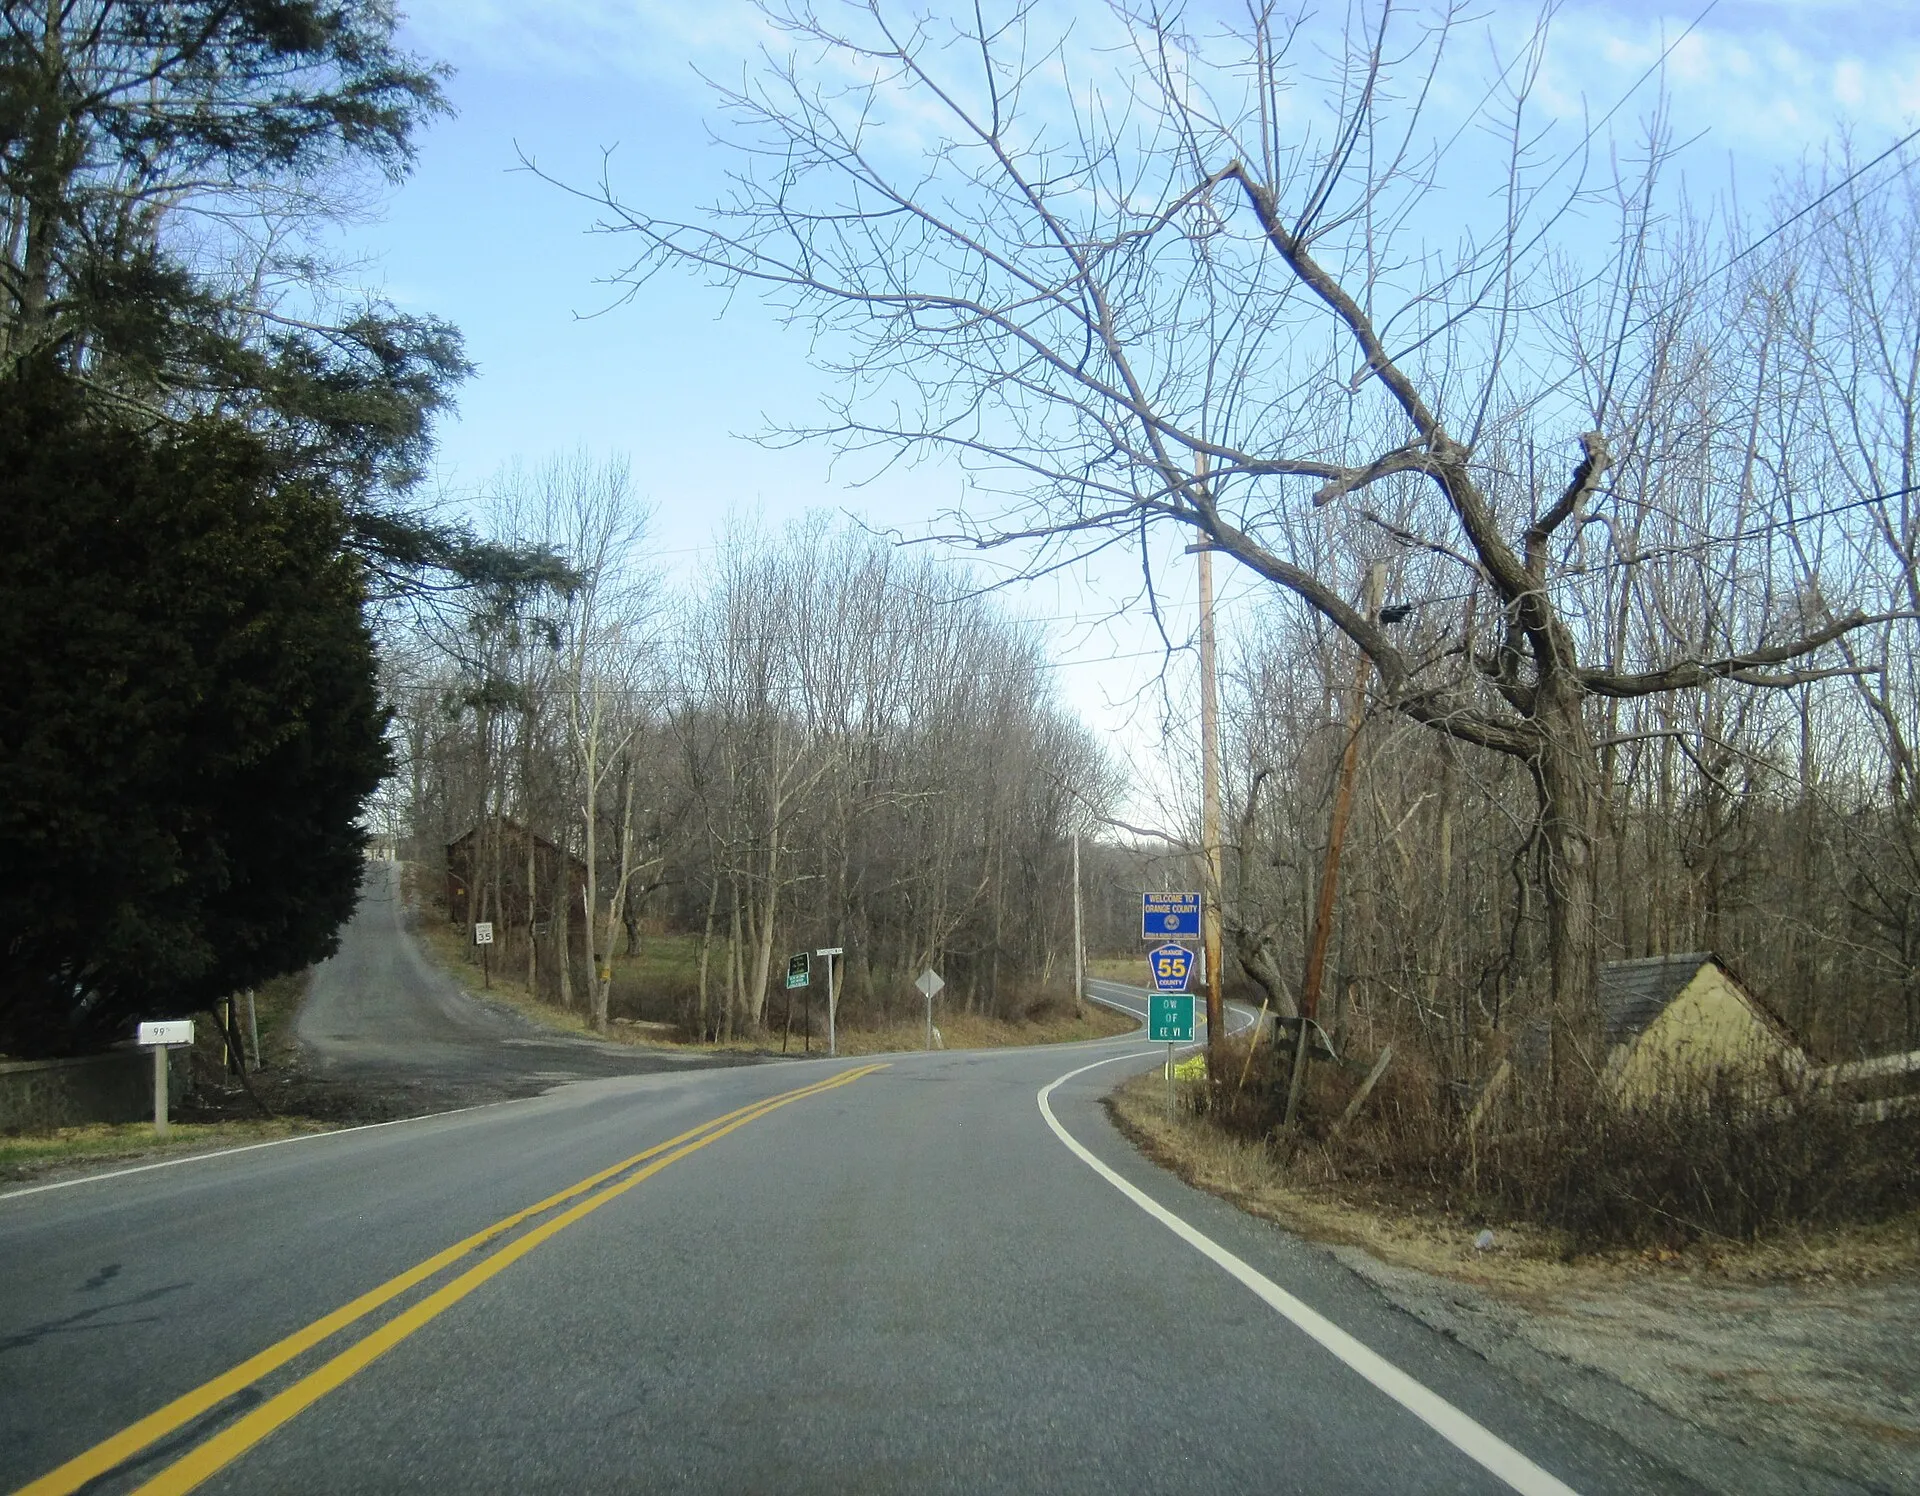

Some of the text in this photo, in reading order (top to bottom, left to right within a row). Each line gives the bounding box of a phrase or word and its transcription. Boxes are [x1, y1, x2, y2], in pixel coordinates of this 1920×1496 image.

[1149, 894, 1194, 903] WELCOME TO
[1145, 904, 1197, 913] ORANGE COUNTY
[478, 933, 491, 941] 35
[1157, 958, 1186, 977] 55
[1165, 1013, 1178, 1023] OF
